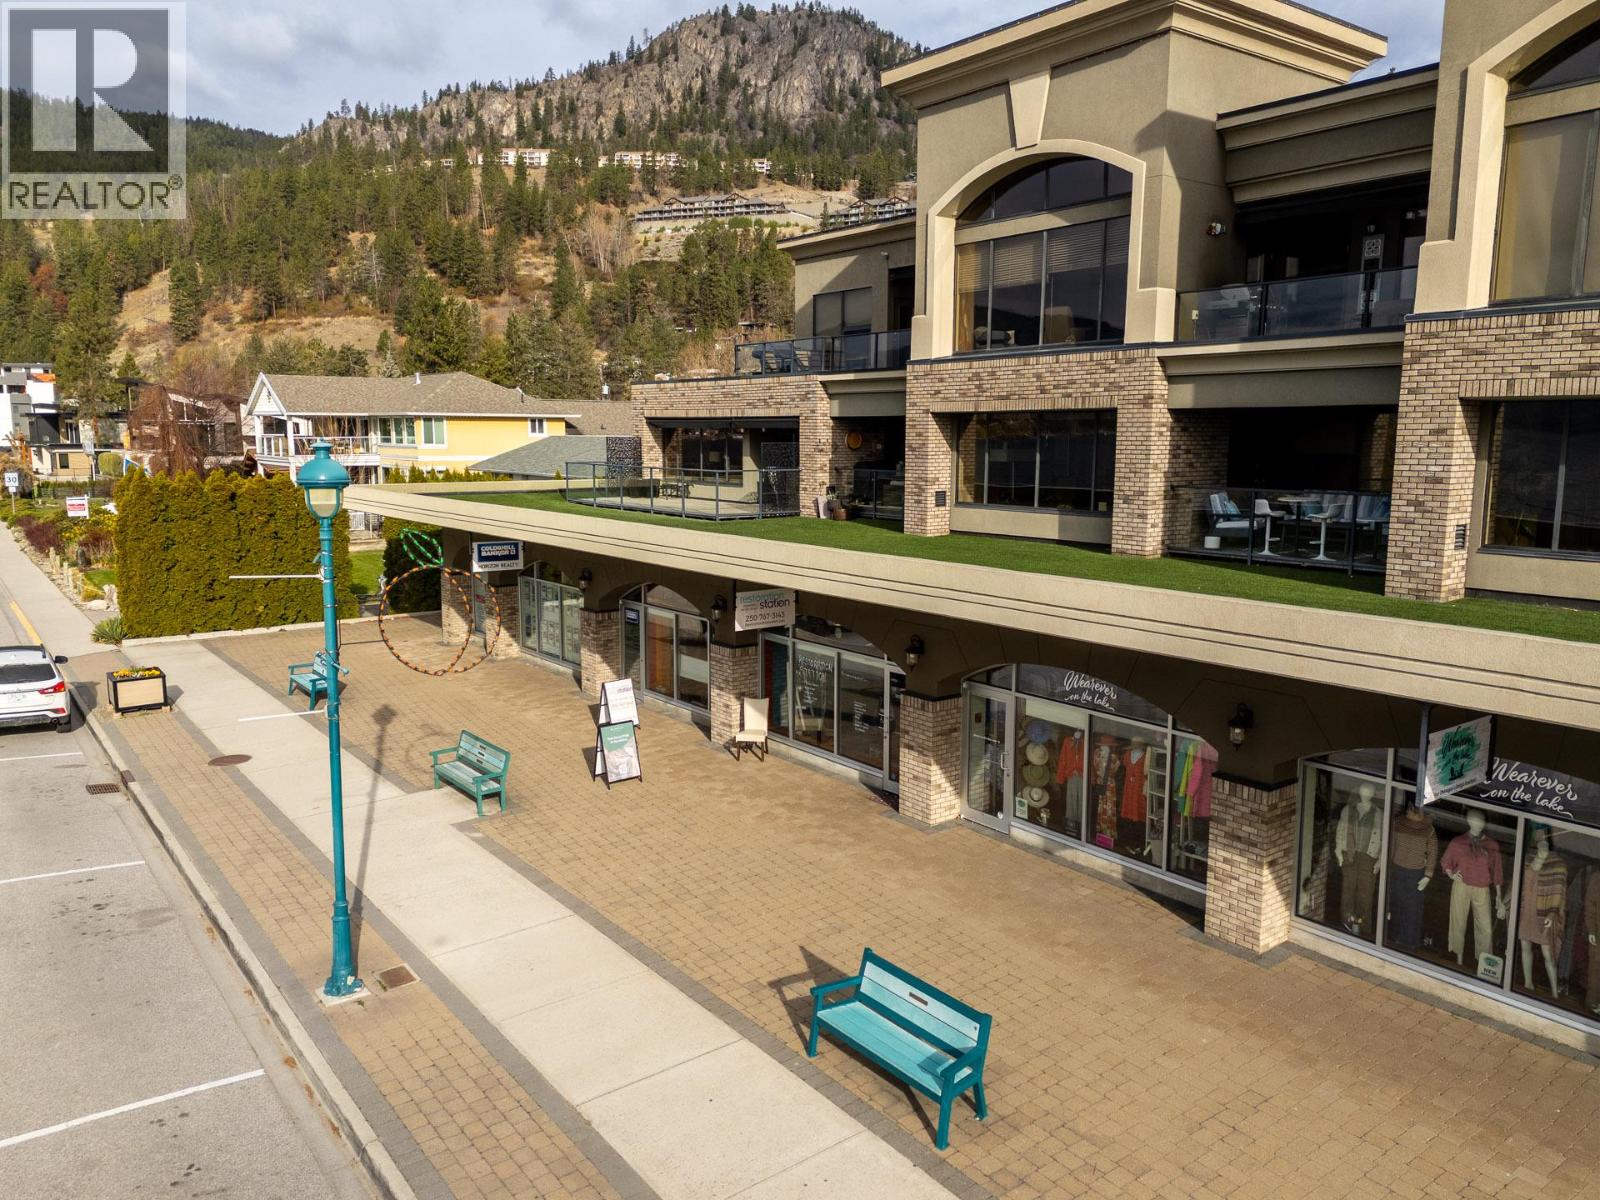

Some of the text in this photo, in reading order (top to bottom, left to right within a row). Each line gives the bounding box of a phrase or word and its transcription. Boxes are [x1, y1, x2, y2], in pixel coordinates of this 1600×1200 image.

[760, 599, 790, 610] station
[1063, 671, 1118, 700] Wearever
[1081, 690, 1093, 704] the
[1483, 756, 1579, 801] Wearever
[1480, 784, 1575, 819] on the lake
